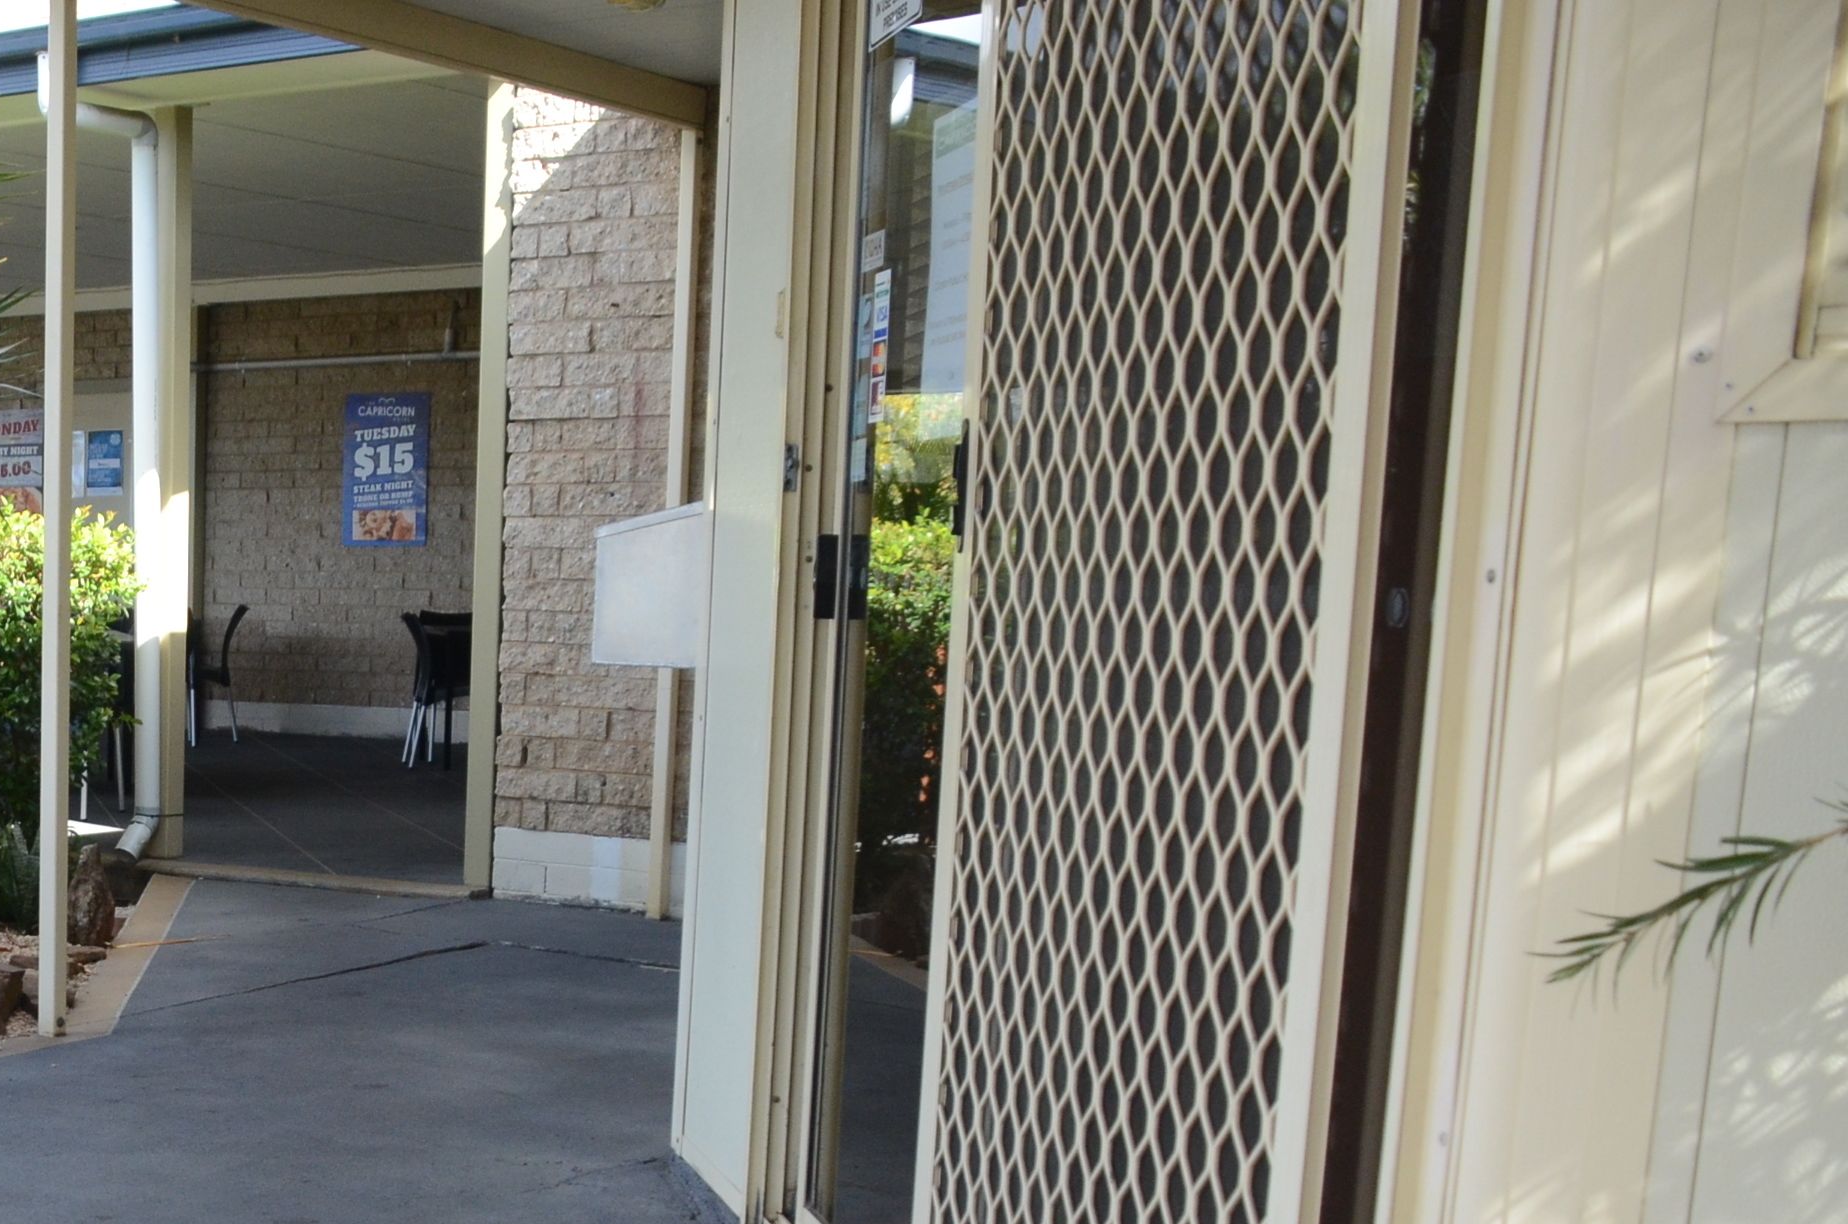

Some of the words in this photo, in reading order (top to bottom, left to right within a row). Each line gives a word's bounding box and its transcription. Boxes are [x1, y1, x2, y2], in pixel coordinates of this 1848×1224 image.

[358, 406, 415, 416] CAPRICORN
[354, 424, 416, 442] TUESDAY
[10, 446, 39, 455] NIGHT
[354, 442, 414, 481] $15
[353, 483, 382, 494] STEAK
[384, 480, 414, 491] NIGHT
